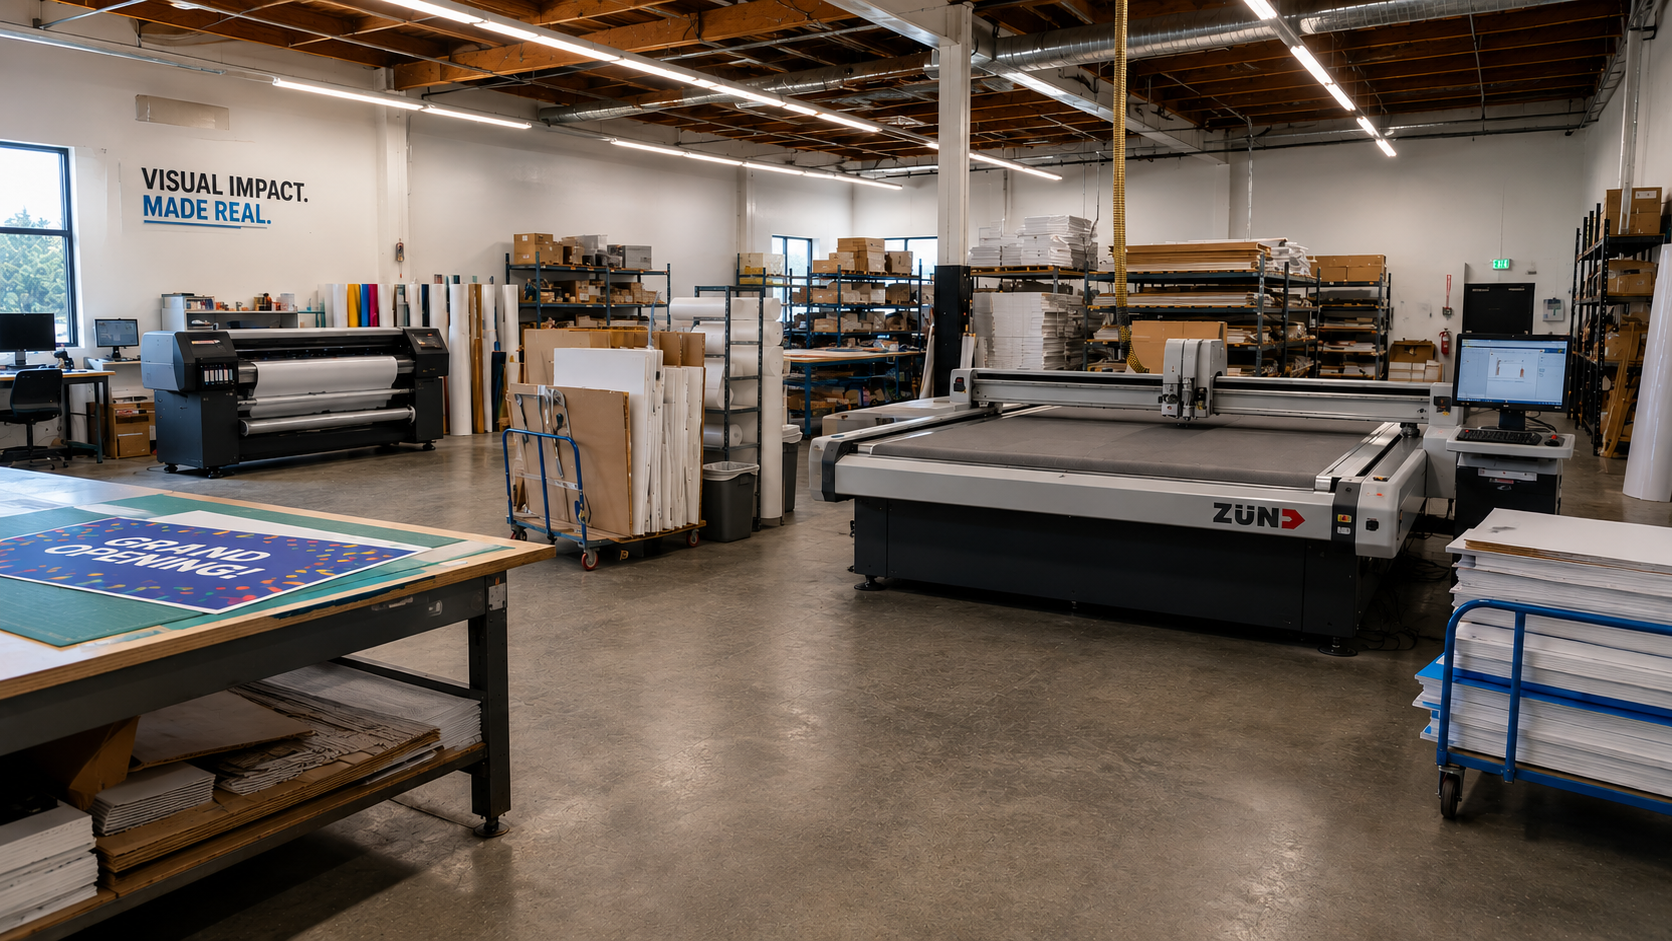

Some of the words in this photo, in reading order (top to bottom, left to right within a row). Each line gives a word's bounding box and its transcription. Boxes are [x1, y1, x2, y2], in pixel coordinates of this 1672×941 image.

[141, 167, 223, 196] VISUAL
[229, 175, 308, 203] IMPACT.
[143, 195, 208, 220] MADE
[215, 201, 271, 224] REAL.
[45, 544, 266, 579] OPENING!
[104, 537, 271, 562] GRAND
